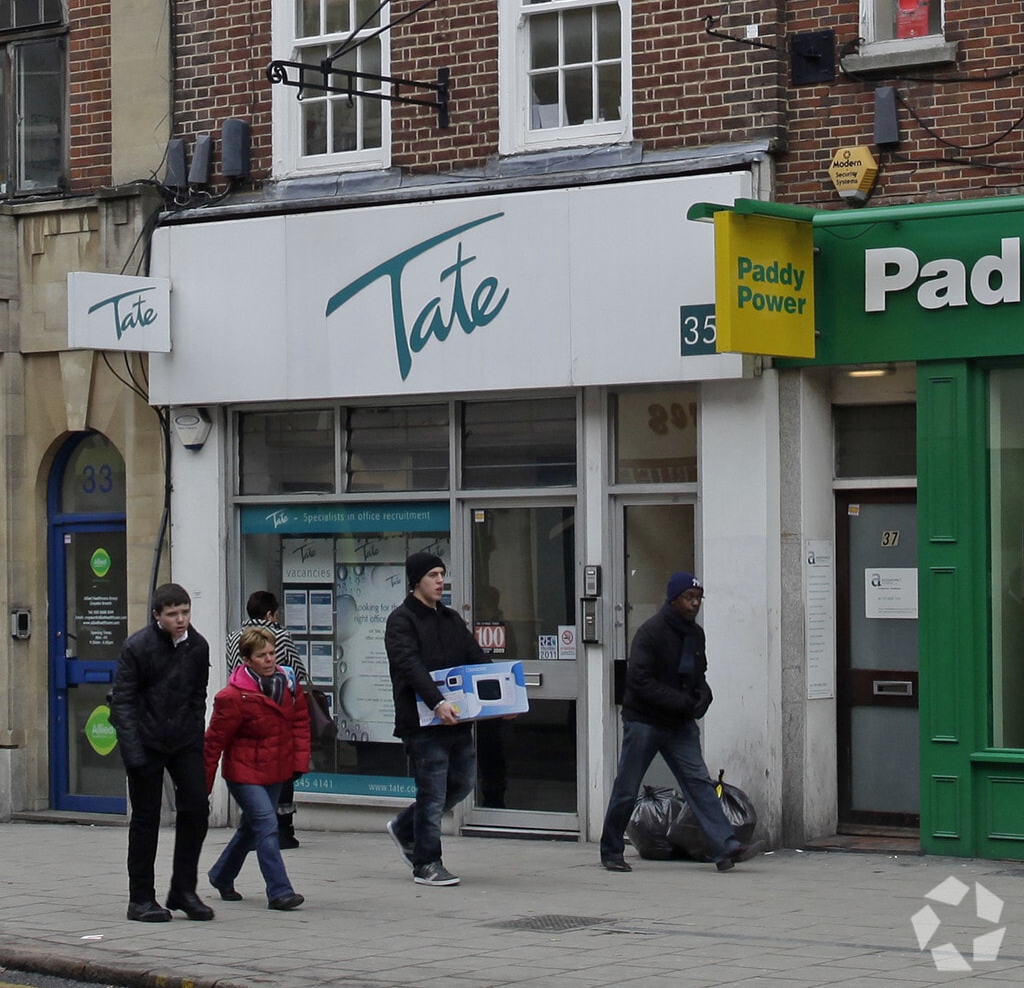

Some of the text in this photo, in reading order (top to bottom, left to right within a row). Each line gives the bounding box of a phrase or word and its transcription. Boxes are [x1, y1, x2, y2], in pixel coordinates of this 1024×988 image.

[833, 160, 862, 168] Modern
[738, 257, 805, 291] Paddy
[865, 237, 1020, 313] Pad
[326, 212, 510, 382] Tate
[738, 286, 806, 315] Power
[88, 286, 158, 340] Tate
[684, 315, 716, 345] 35
[82, 464, 112, 494] 33
[265, 508, 289, 529] Tate
[304, 512, 345, 524] Specialists
[357, 512, 380, 520] office
[383, 511, 430, 520] recruitment
[883, 532, 898, 546] 37
[292, 541, 316, 563] Tate
[354, 542, 380, 561] Tate
[286, 567, 331, 578] vacancies
[356, 603, 380, 613] Looking
[380, 603, 390, 611] for
[354, 616, 368, 625] right
[477, 626, 505, 647] 100
[540, 651, 557, 659] 2011
[312, 779, 333, 788] 4141
[368, 783, 416, 792] www.tate.co
